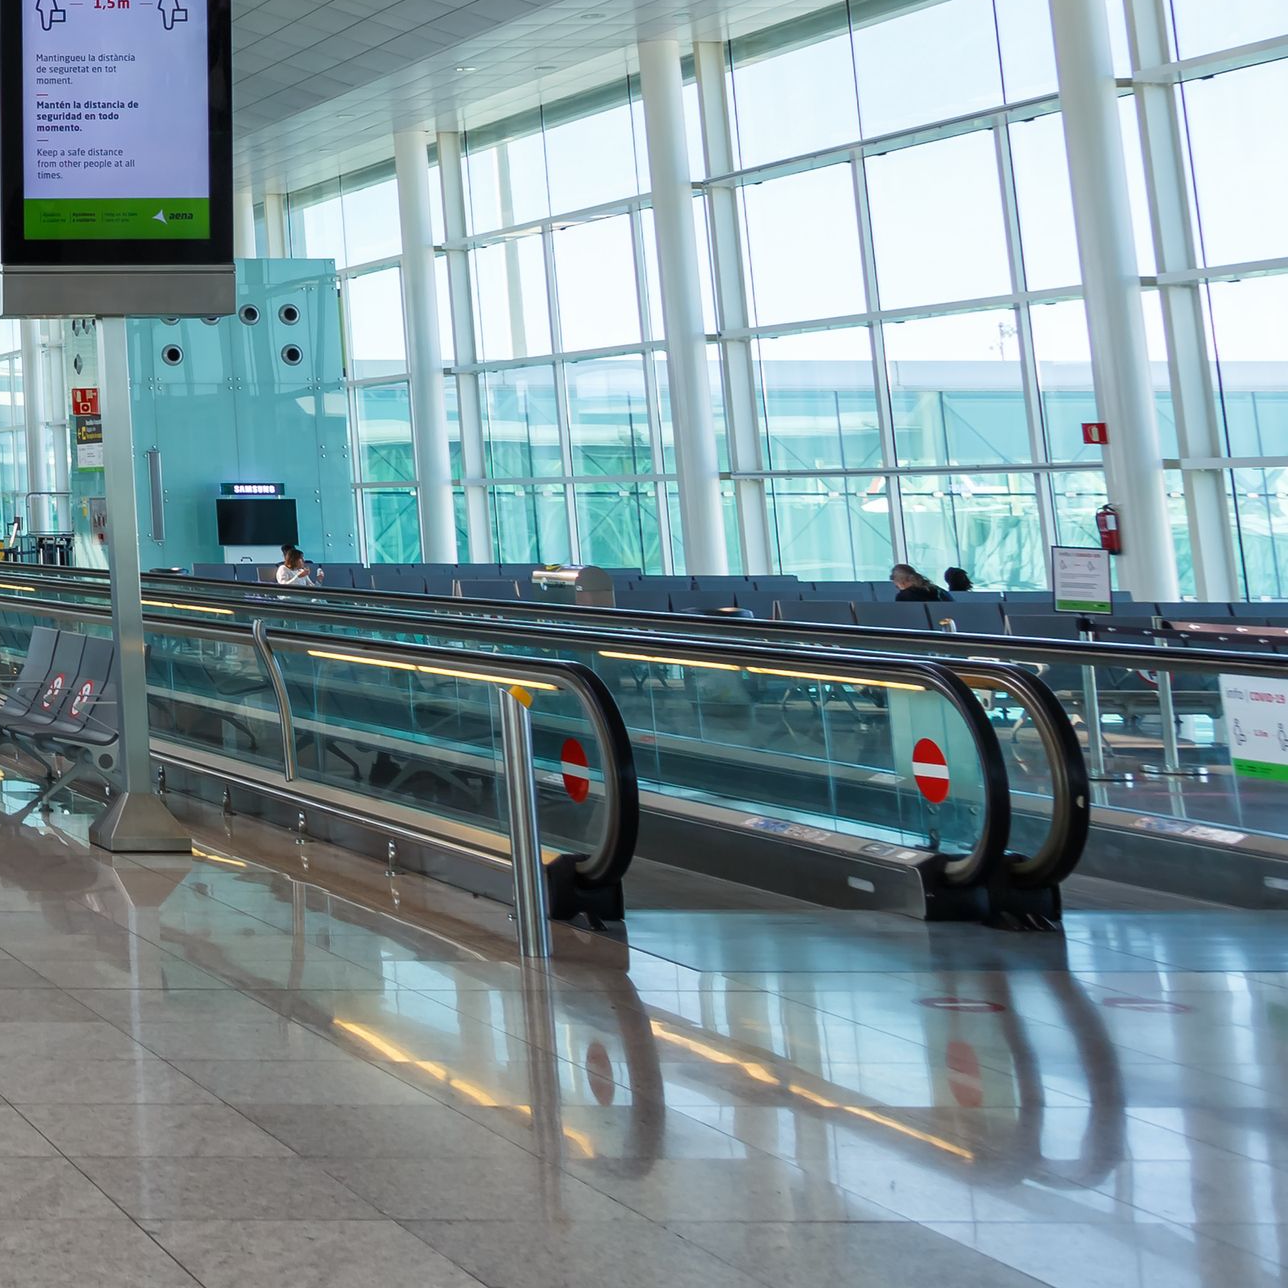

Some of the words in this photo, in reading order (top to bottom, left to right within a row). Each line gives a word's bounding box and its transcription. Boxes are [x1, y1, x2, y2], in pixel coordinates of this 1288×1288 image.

[36, 54, 86, 63] Mantingueu
[88, 54, 96, 62] la
[98, 53, 135, 62] distància
[36, 65, 46, 73] de
[49, 66, 89, 75] seguretat
[105, 65, 116, 73] tot
[36, 77, 73, 85] moment.
[36, 100, 71, 109] Mantén
[73, 100, 81, 109] la
[84, 100, 125, 109] distancia
[127, 100, 139, 109] de
[36, 112, 82, 122] seguridad
[98, 112, 119, 120] todo
[36, 124, 82, 132] momento.
[37, 149, 58, 157] Keep
[67, 148, 85, 156] safe
[87, 148, 123, 156] distance
[37, 160, 57, 168] from
[59, 160, 81, 168] other
[83, 160, 112, 169] people
[115, 160, 122, 168] at
[125, 159, 135, 168] all
[169, 212, 194, 220] aena
[234, 485, 275, 493] SAMSUNG
